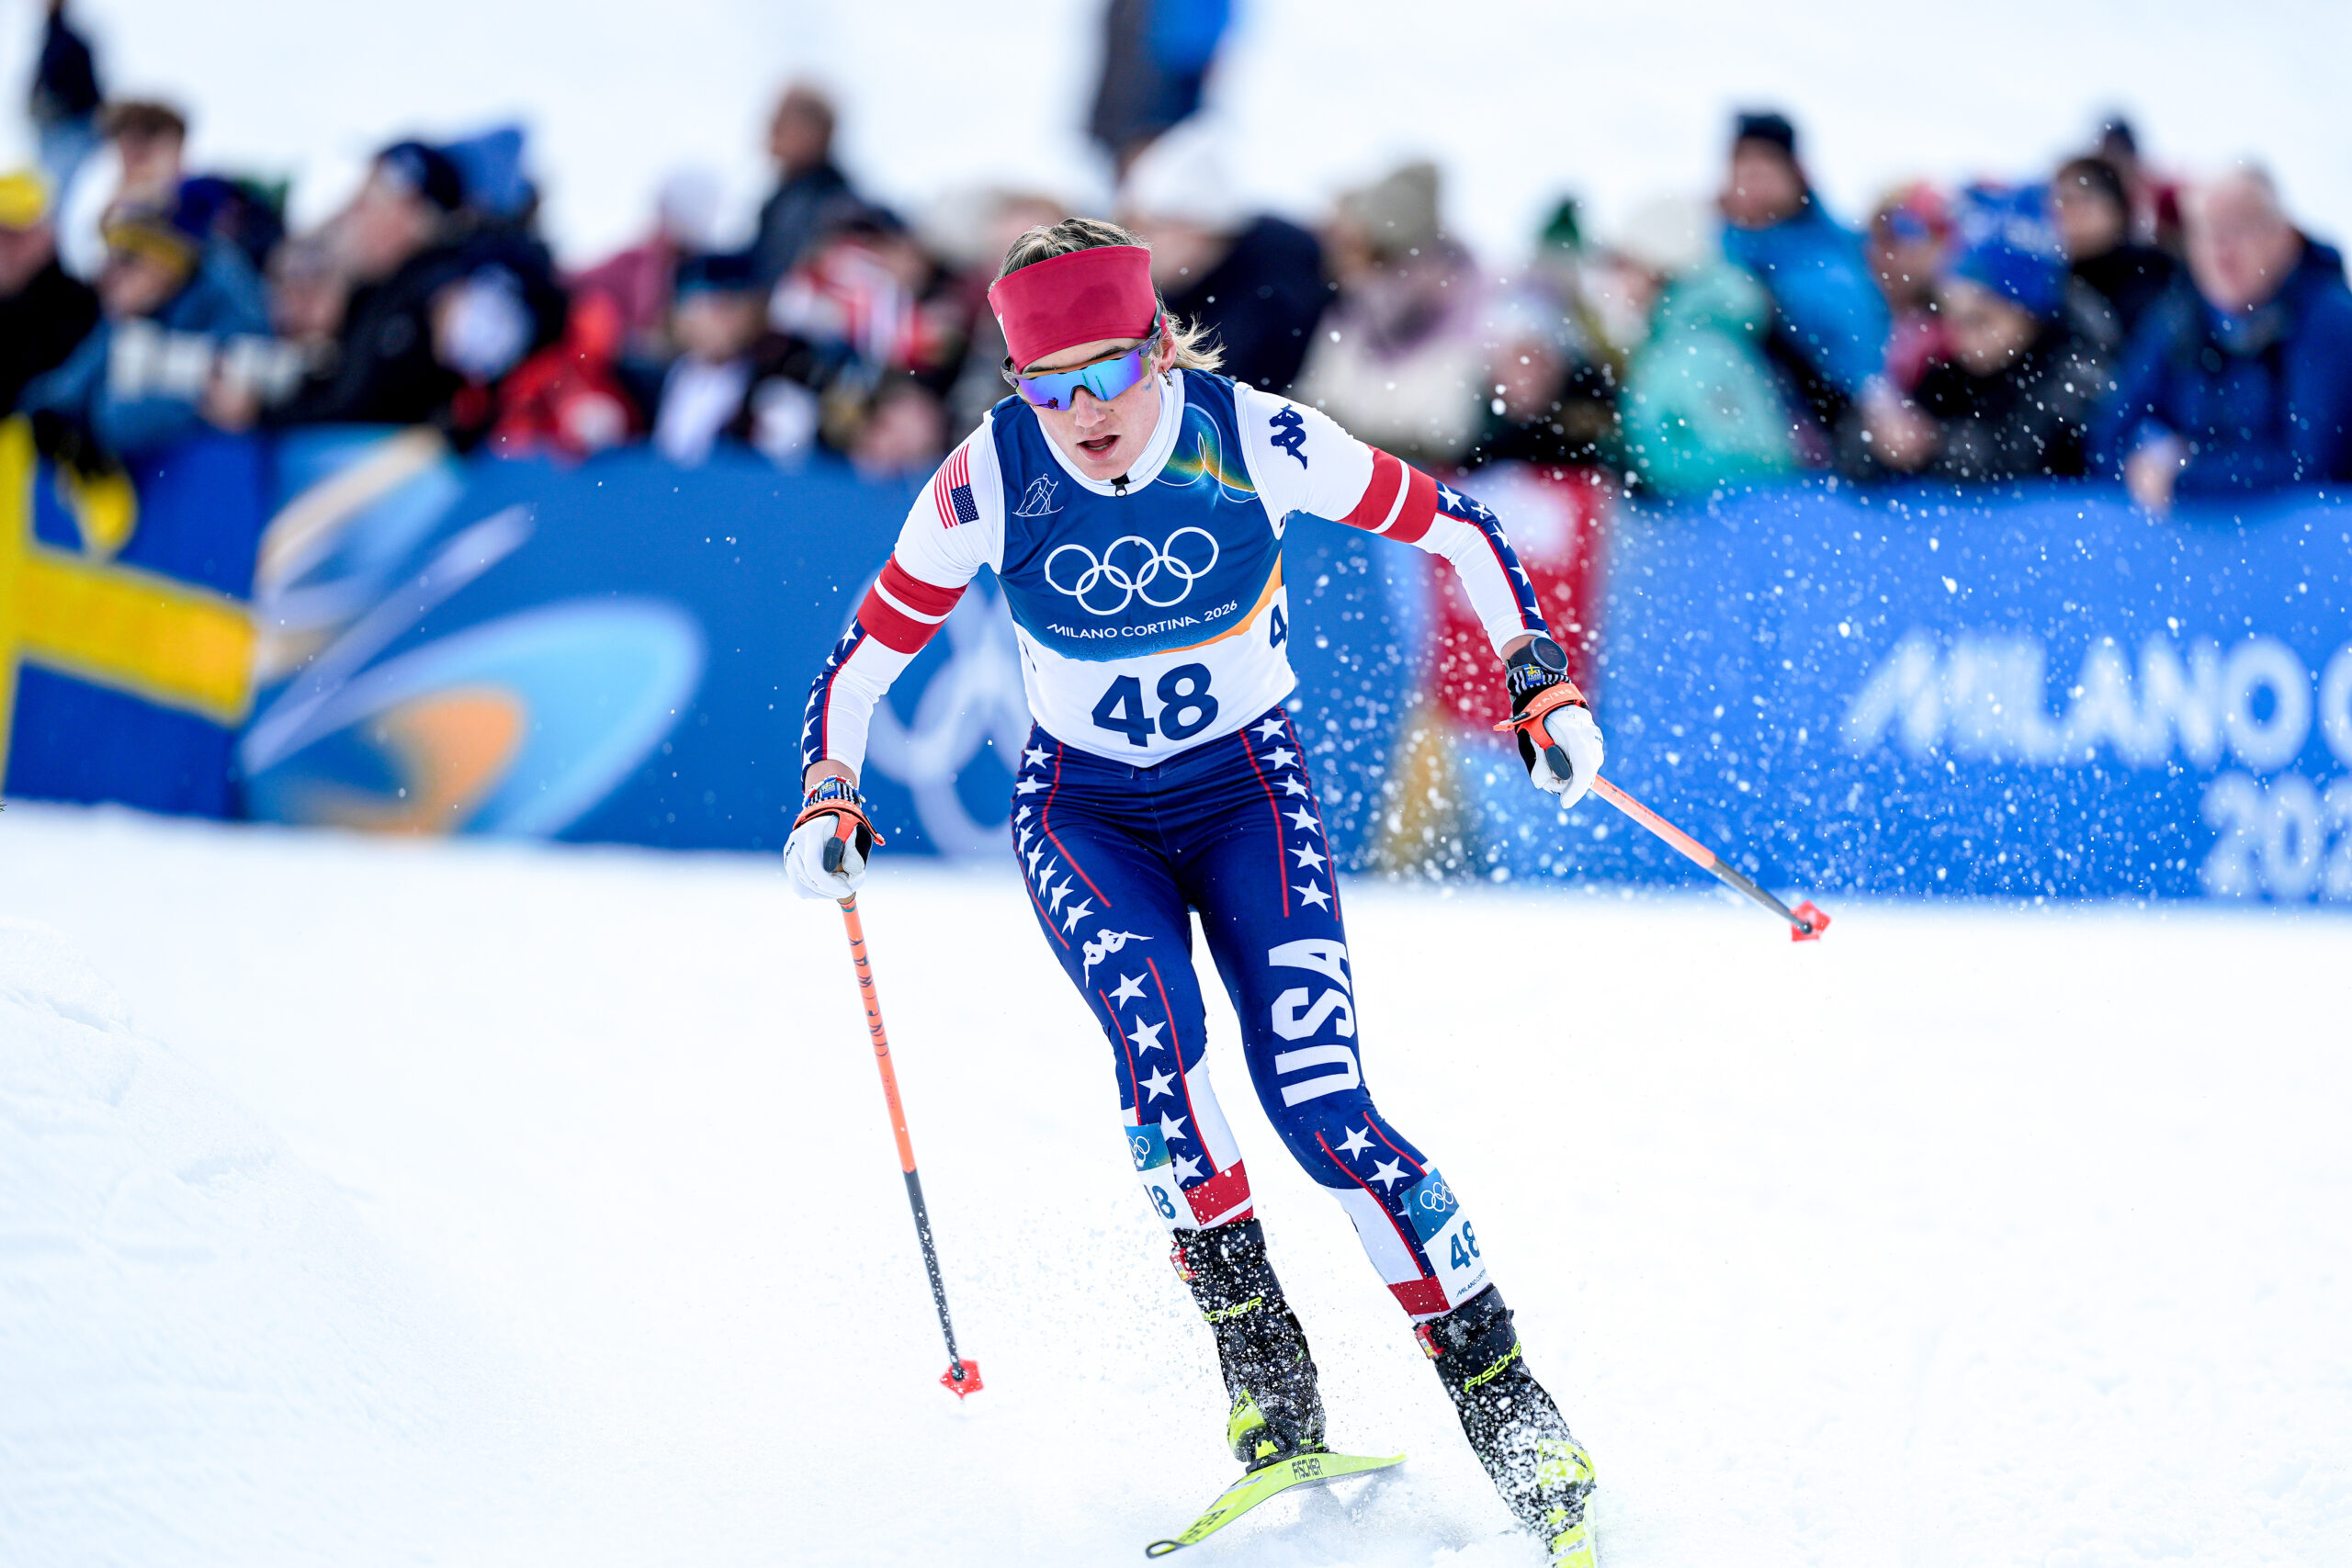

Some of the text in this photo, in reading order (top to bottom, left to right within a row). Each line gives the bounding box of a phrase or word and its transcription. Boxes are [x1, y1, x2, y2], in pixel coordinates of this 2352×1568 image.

[1046, 599, 1238, 639] MILANO CORTINA 2026
[1091, 662, 1219, 748] 48
[1840, 634, 2312, 770] MILANO
[1268, 938, 1361, 1108] USA
[1451, 1220, 1480, 1270] 48
[1203, 1296, 1262, 1323] CHER
[1291, 1457, 1324, 1481] FISCHER
